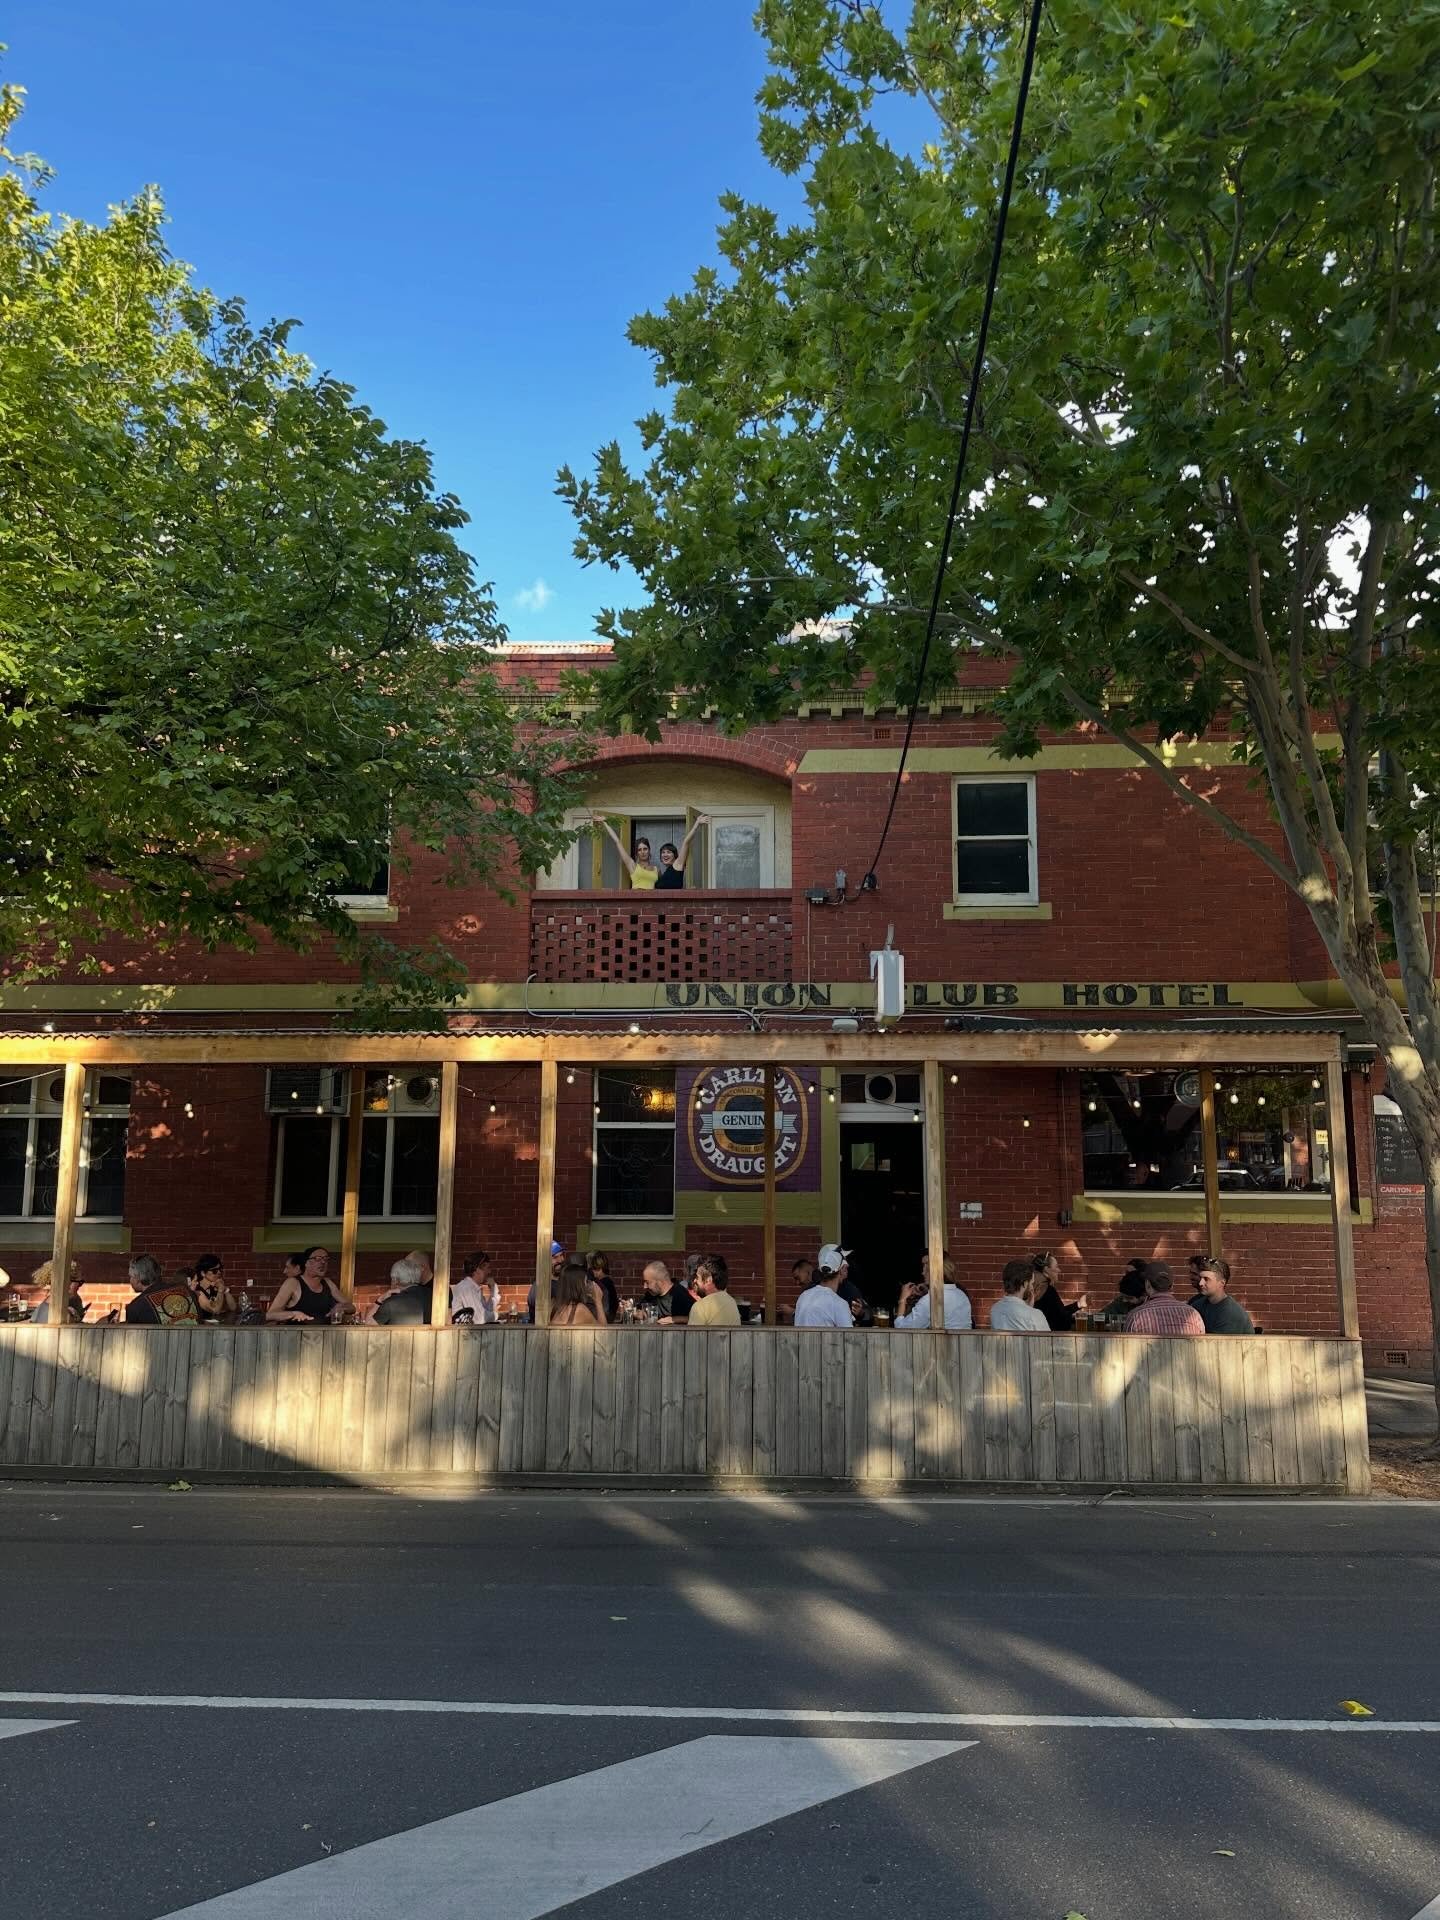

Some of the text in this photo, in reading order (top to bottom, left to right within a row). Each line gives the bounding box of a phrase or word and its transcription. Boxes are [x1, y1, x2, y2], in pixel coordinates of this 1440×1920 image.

[665, 983, 1244, 1007] UNION LUB HOTEL
[721, 1114, 766, 1126] GENUIN
[1379, 1186, 1412, 1194] CARLTON
